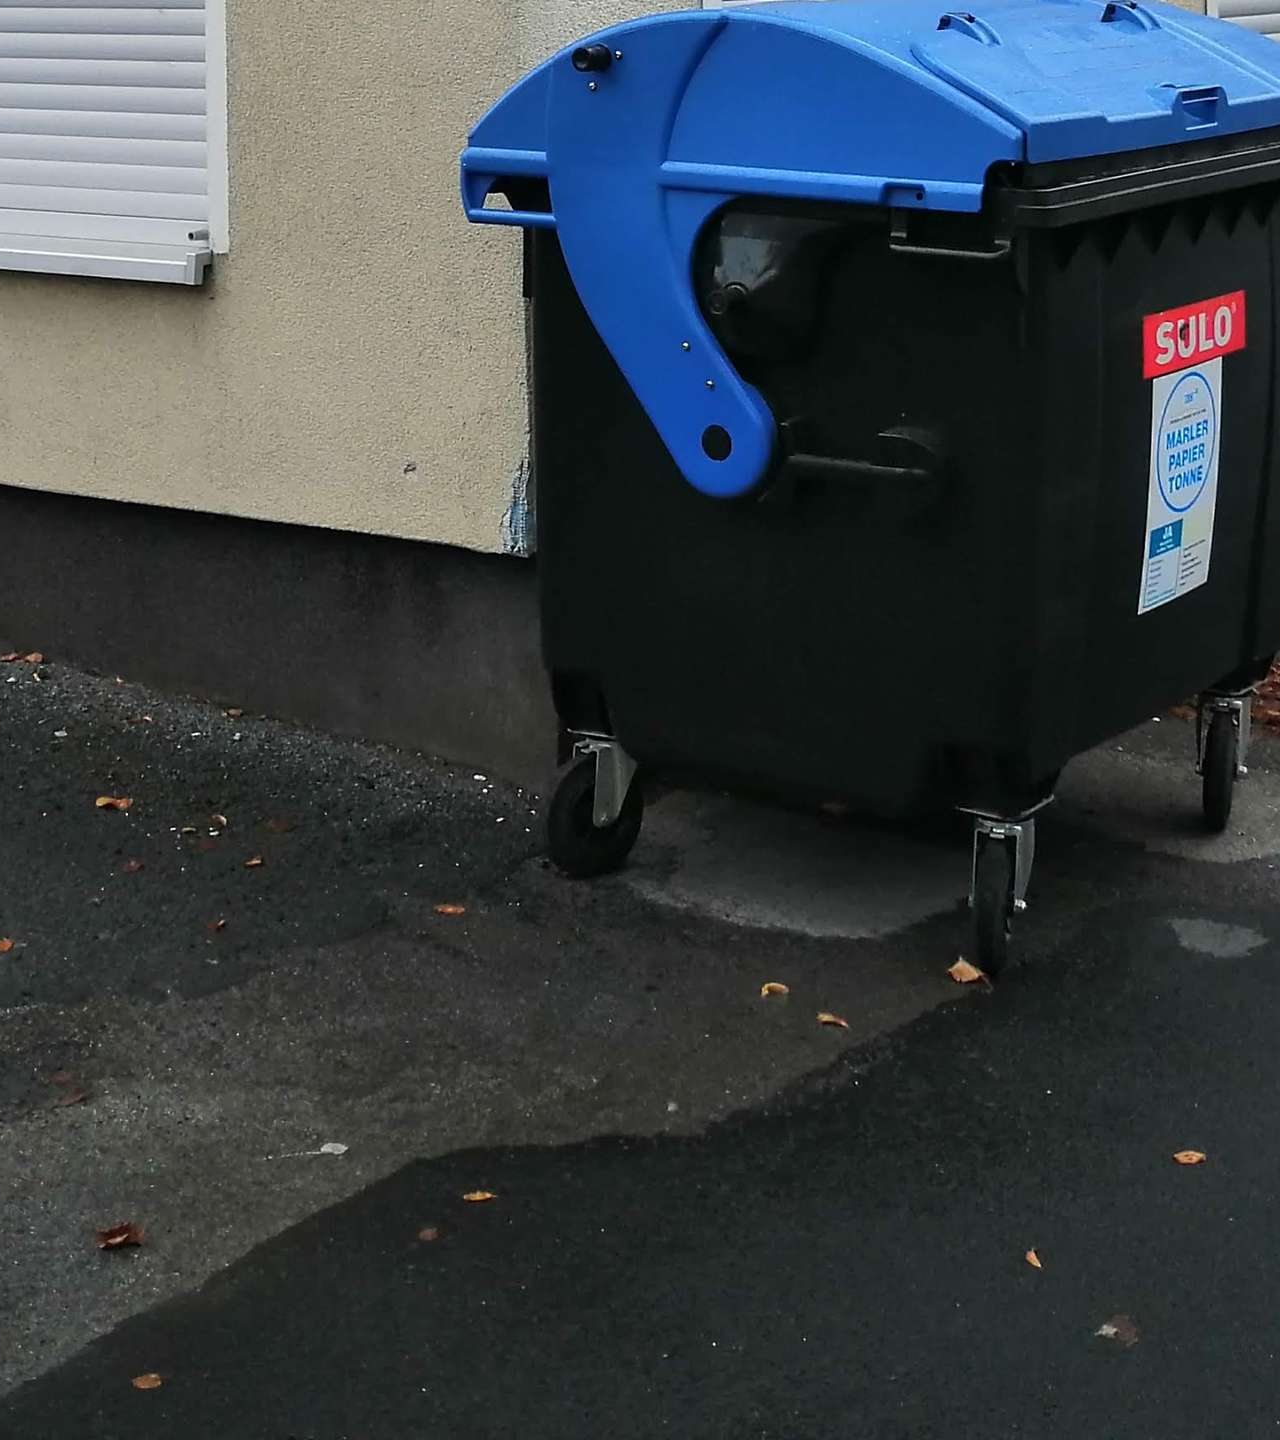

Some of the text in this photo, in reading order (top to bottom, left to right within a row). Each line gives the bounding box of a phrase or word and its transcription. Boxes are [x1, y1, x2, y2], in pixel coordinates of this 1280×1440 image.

[1155, 305, 1233, 366] SULO
[1166, 419, 1209, 450] MARLER
[1168, 443, 1206, 472] PAPIER
[1167, 464, 1204, 494] TONNE
